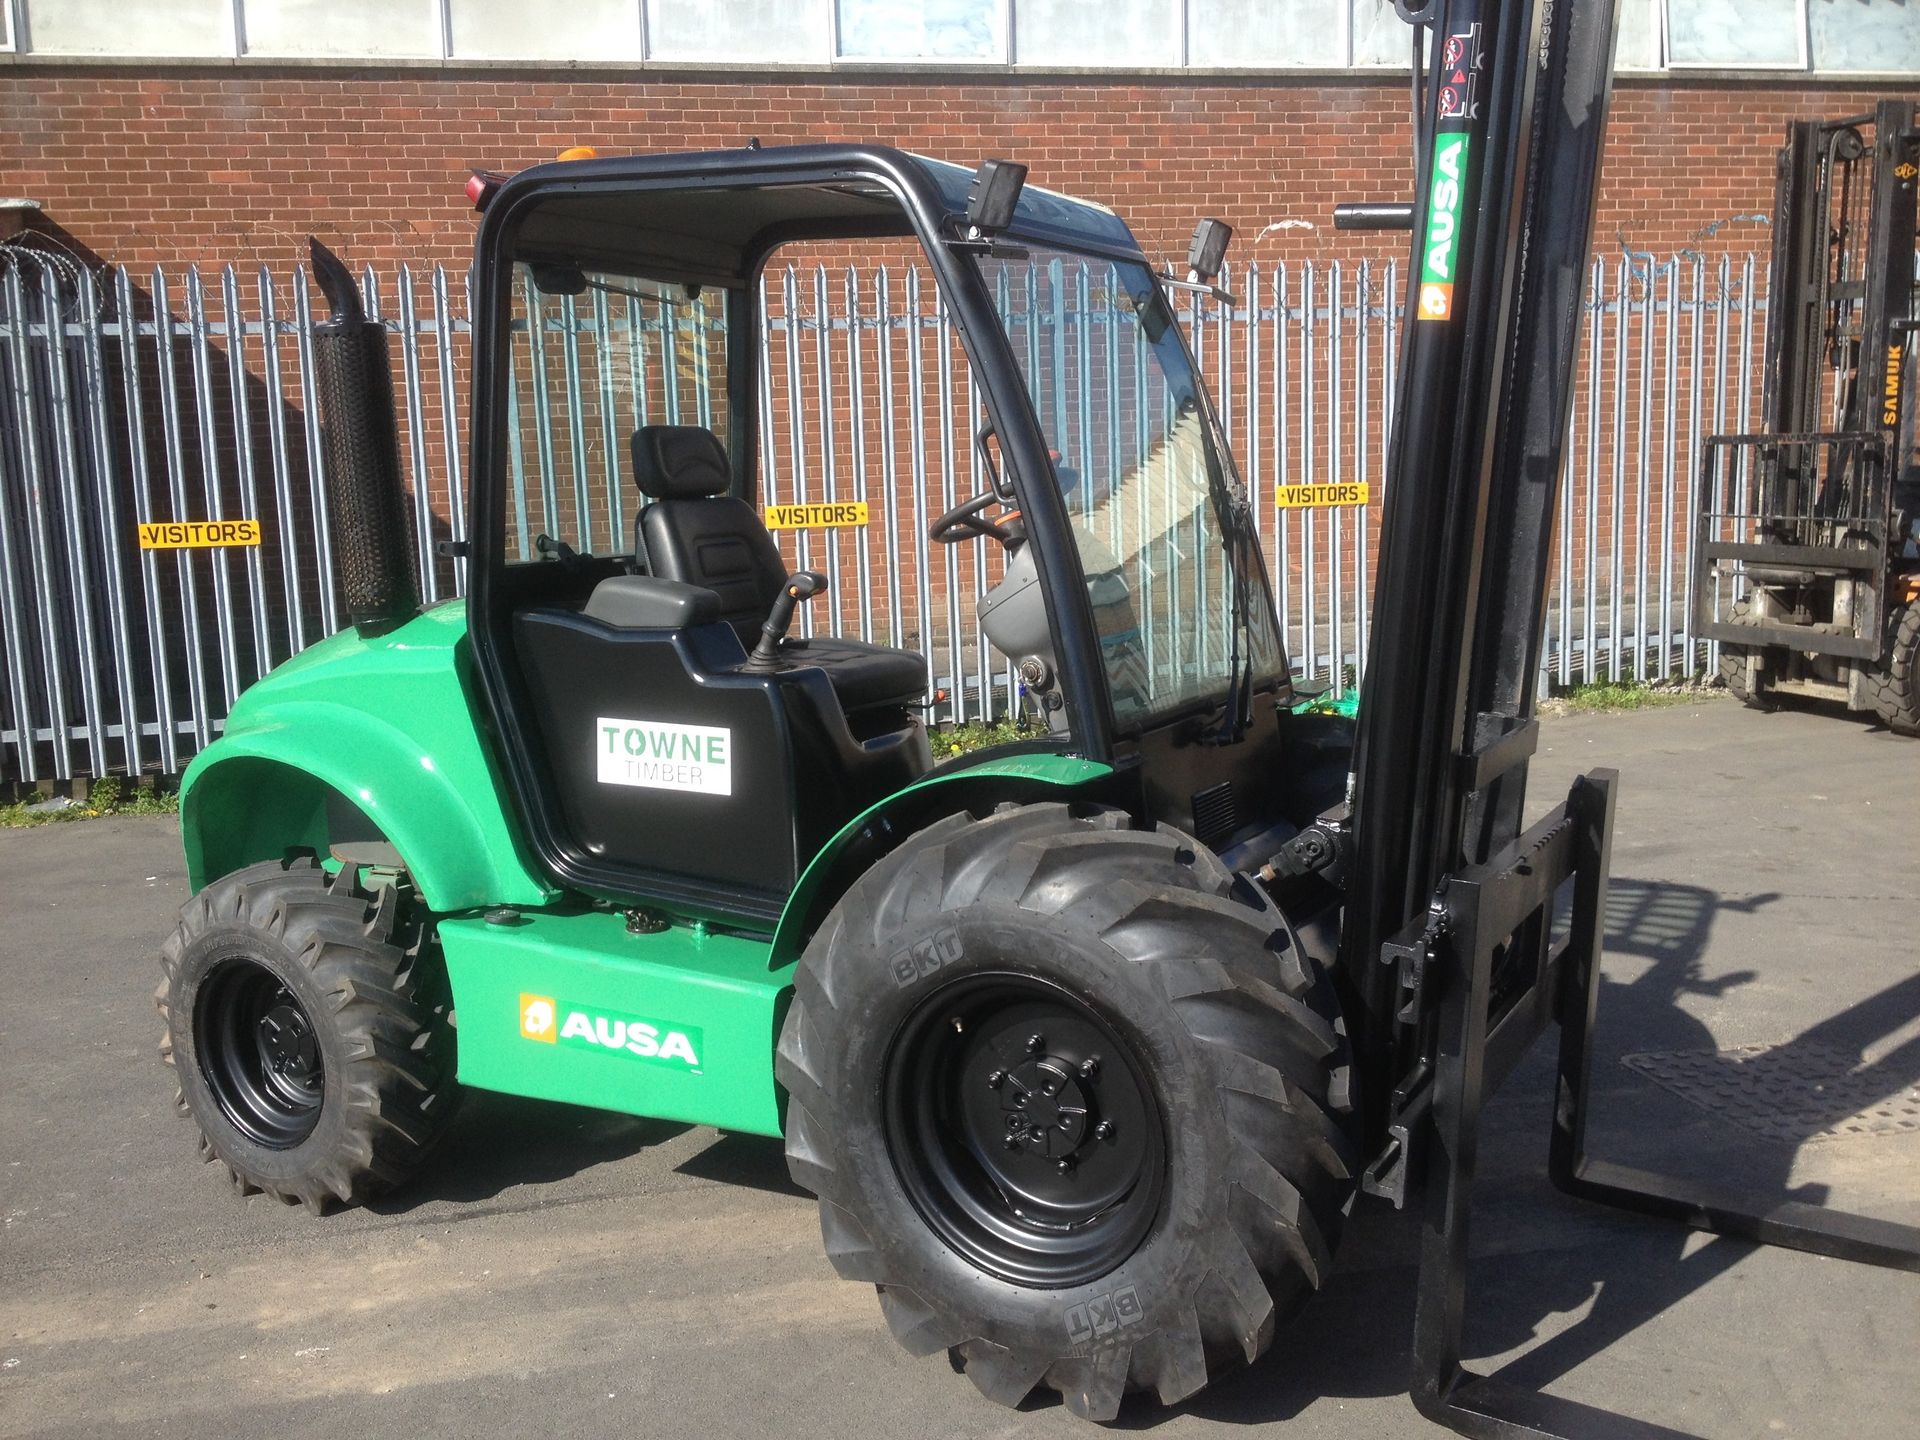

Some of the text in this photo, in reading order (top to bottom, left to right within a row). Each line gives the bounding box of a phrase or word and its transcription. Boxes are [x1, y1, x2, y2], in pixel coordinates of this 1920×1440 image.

[1428, 140, 1462, 278] AUSA
[1883, 345, 1901, 425] SAMUK
[777, 506, 857, 525] VISITORS
[1287, 486, 1358, 504] VISITORS
[147, 523, 252, 543] VISITORS
[603, 727, 725, 764] TOWNE
[625, 760, 703, 785] TIMBER
[890, 930, 960, 985] BKT
[560, 1011, 699, 1065] AUSA
[1068, 1289, 1142, 1339] BKT
